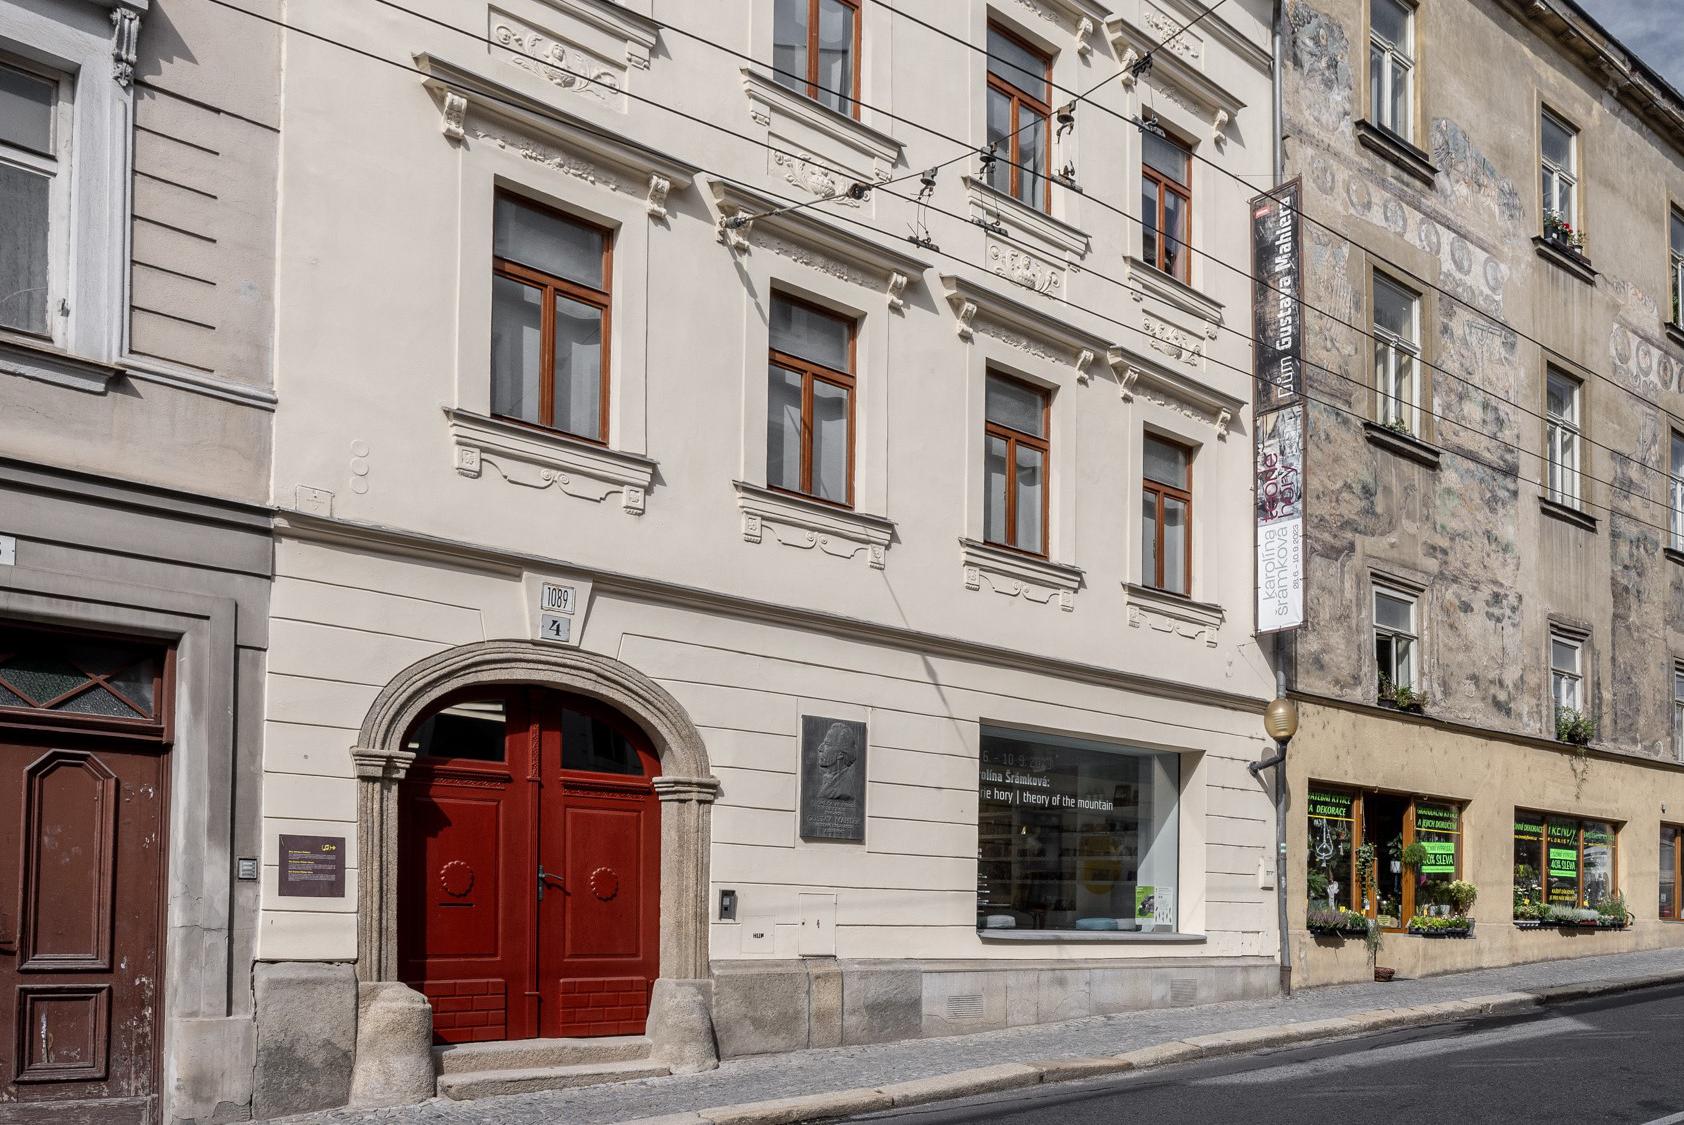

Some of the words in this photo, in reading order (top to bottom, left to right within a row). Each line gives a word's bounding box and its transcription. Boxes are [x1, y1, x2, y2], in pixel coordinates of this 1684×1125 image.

[1275, 196, 1292, 272] Mahlera
[1276, 275, 1292, 350] Gustava
[1277, 356, 1294, 398] Dům
[1278, 465, 1298, 518] hory
[1262, 529, 1276, 600] karolína
[1275, 526, 1289, 616] šrámková
[548, 587, 569, 609] 1089
[549, 619, 562, 637] 4
[1005, 769, 1050, 787] Šrámková:
[994, 787, 1013, 804] hory
[1023, 790, 1050, 808] theory
[1052, 794, 1060, 806] of
[1063, 795, 1075, 808] the
[1077, 798, 1114, 811] mountain
[1309, 804, 1314, 813] A
[1316, 804, 1346, 816] DEKORACE
[1436, 854, 1454, 865] SLEVA
[1562, 860, 1576, 870] SLEVA
